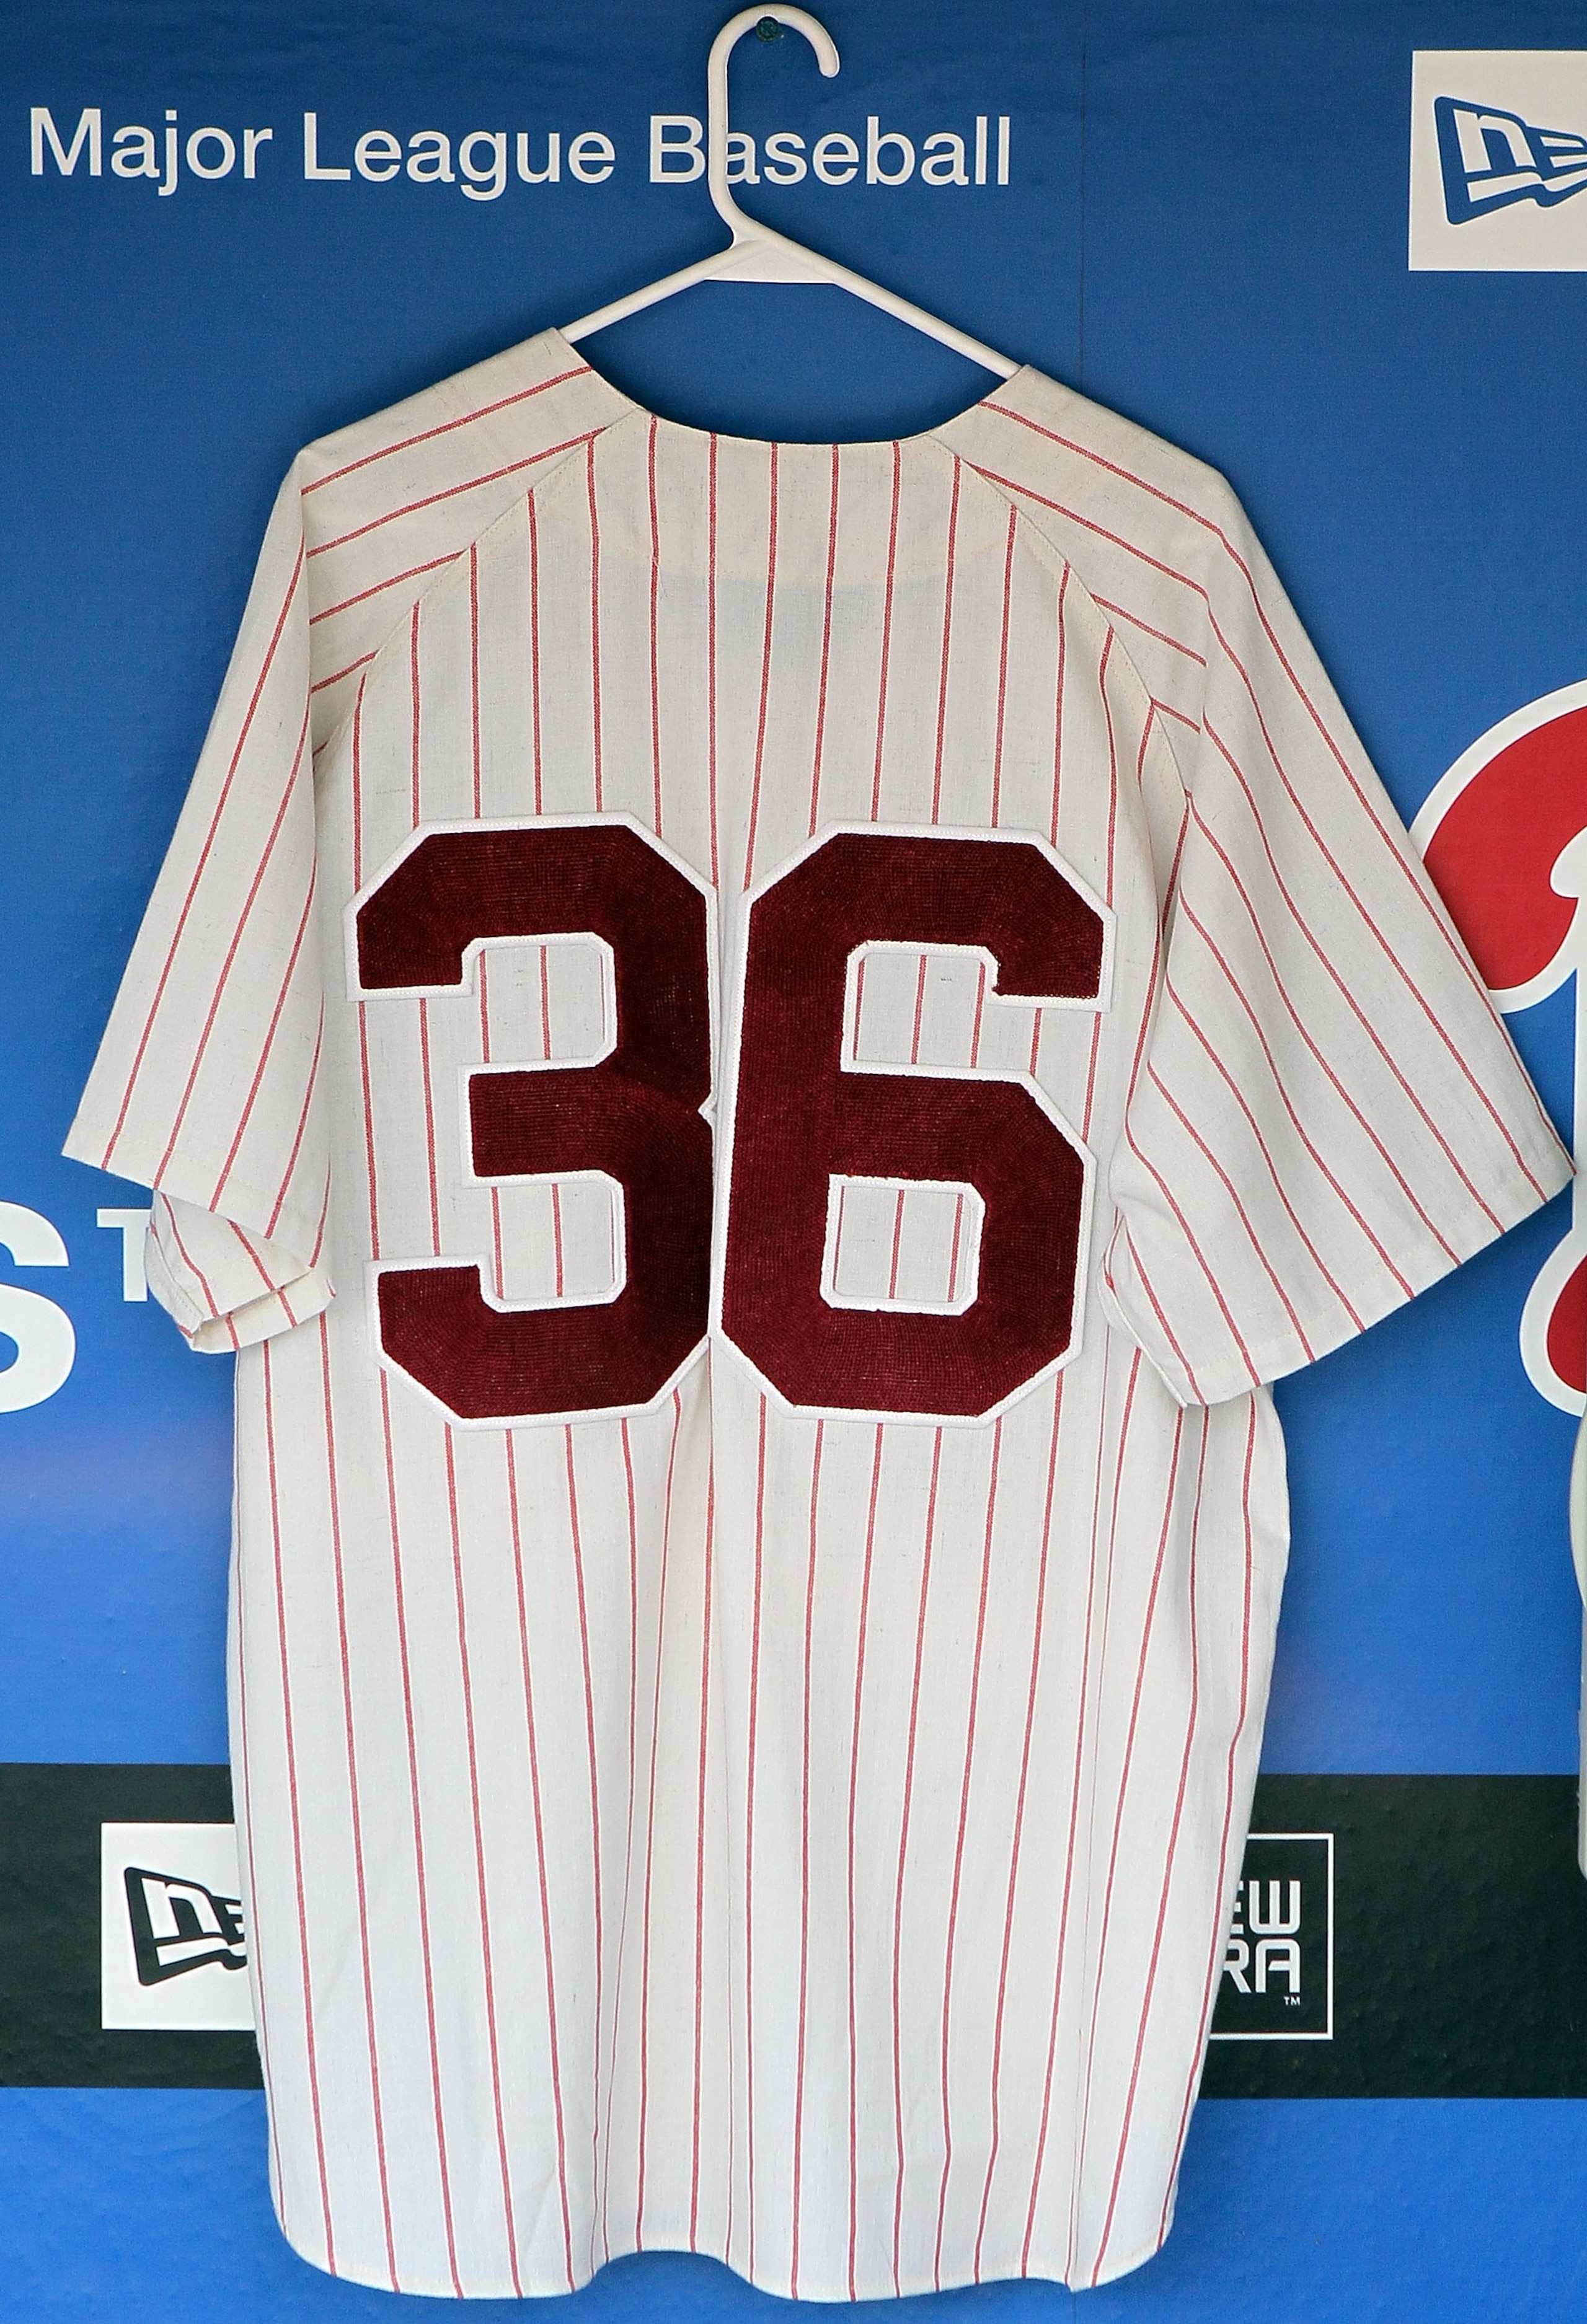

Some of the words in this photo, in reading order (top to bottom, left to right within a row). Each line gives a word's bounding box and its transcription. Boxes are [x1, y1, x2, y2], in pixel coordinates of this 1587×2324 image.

[30, 107, 273, 196] Major
[304, 112, 616, 201] League
[650, 115, 1010, 185] Baseball
[343, 811, 1116, 1432] 36
